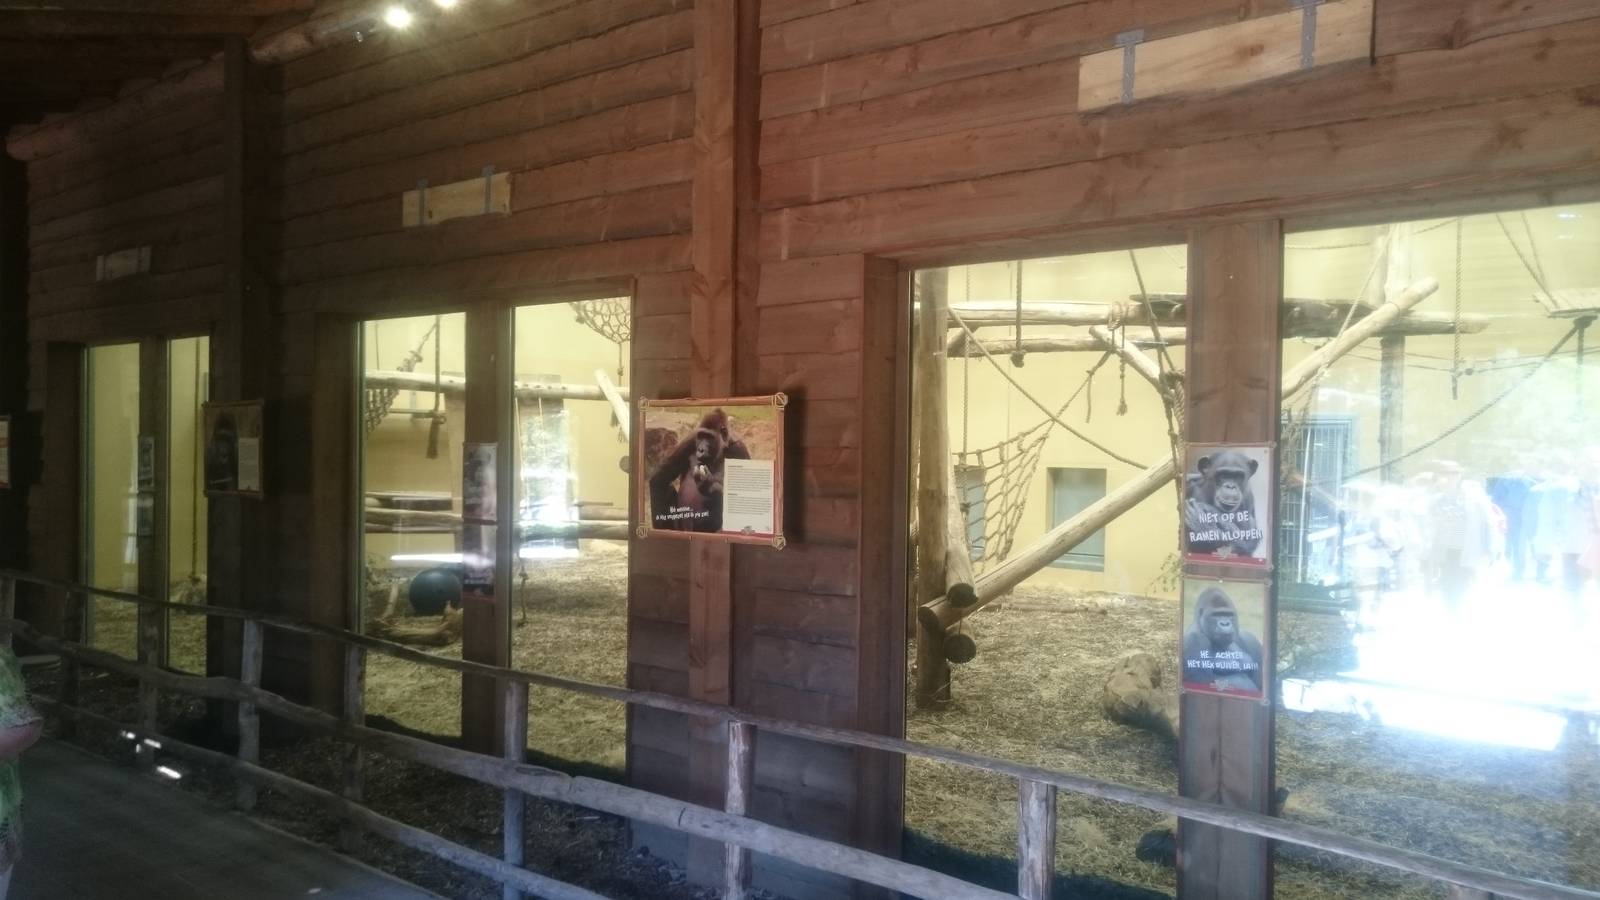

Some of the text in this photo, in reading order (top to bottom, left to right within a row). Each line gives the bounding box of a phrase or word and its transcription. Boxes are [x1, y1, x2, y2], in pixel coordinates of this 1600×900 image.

[1199, 510, 1249, 524] NIET OP DE
[1189, 530, 1220, 543] RAMEN
[1215, 650, 1244, 660] ACHTER
[1187, 659, 1201, 669] HET
